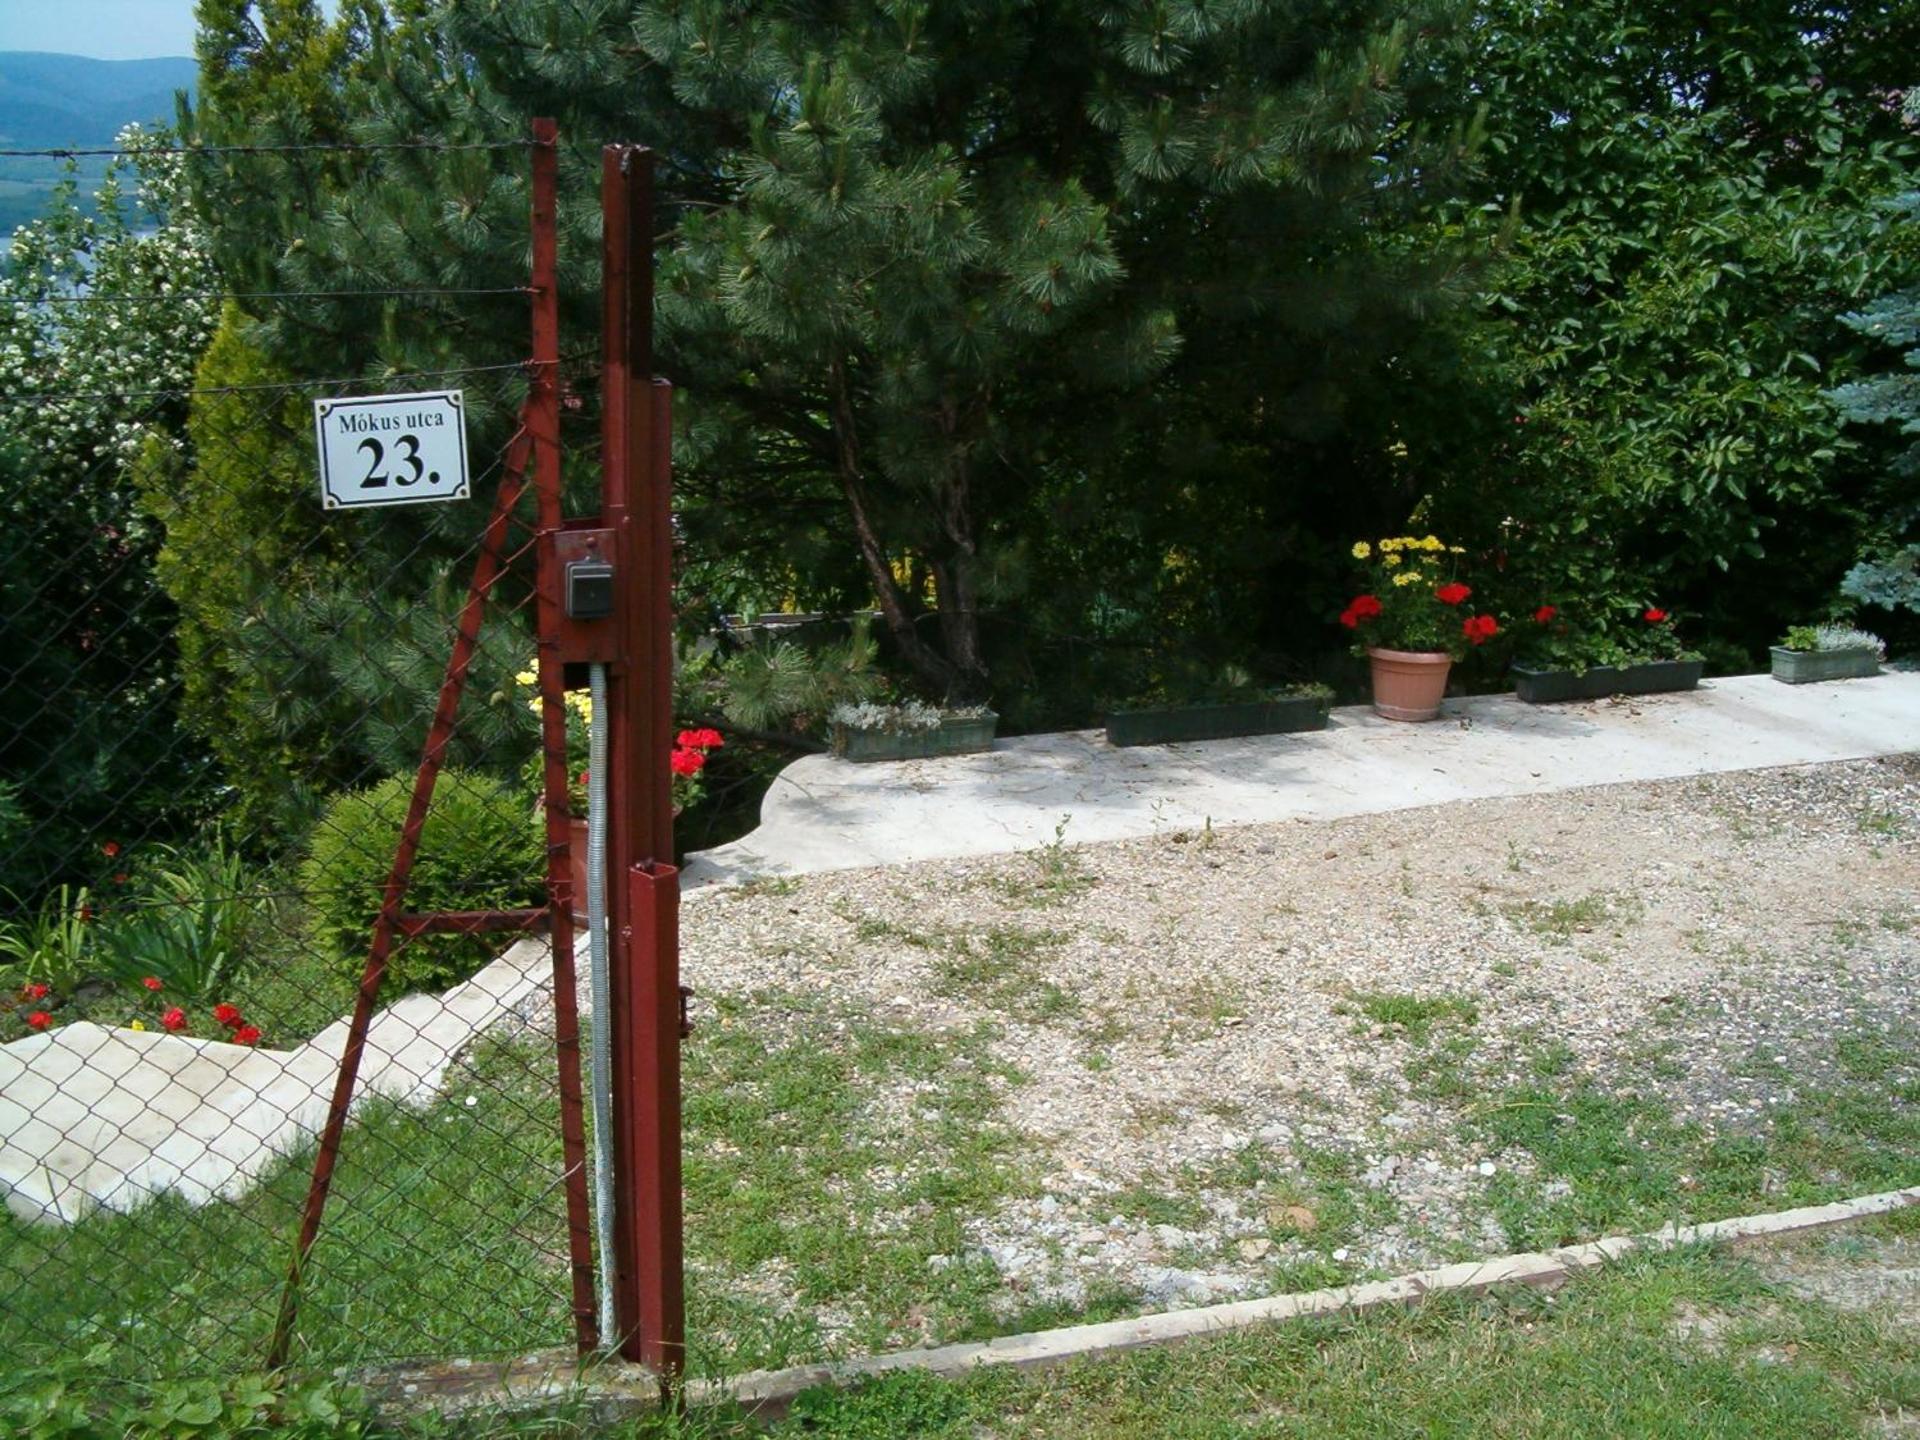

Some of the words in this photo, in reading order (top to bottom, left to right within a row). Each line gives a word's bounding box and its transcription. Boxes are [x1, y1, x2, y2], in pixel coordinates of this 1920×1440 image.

[338, 412, 400, 433] Mókus
[406, 411, 444, 428] utca
[357, 434, 440, 488] 23.
